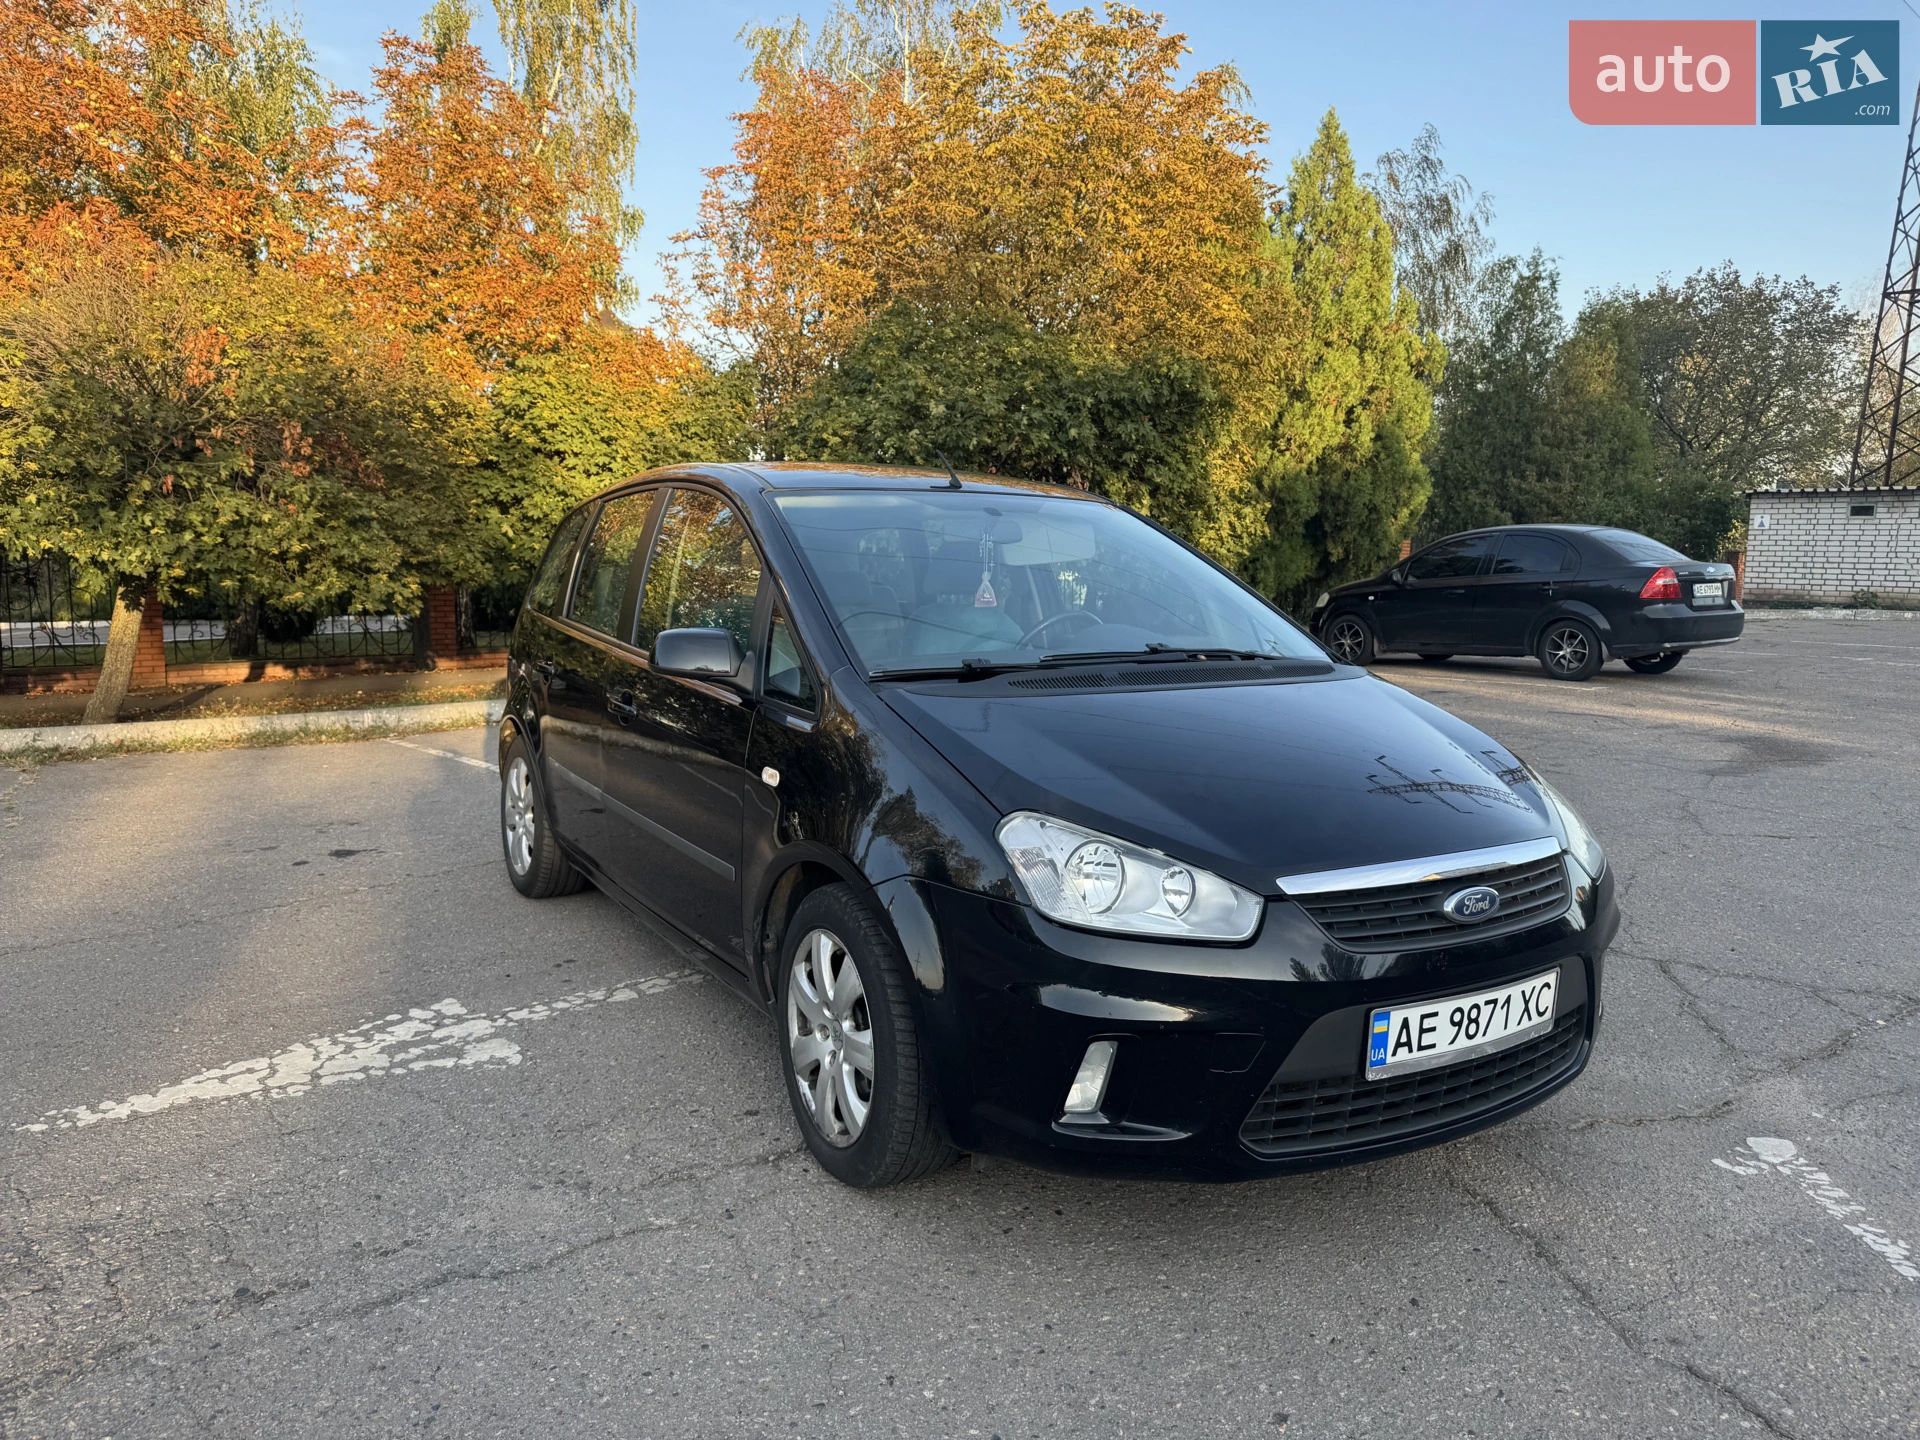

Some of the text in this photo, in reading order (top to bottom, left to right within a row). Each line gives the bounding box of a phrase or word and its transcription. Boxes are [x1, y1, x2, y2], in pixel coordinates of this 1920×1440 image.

[1463, 894, 1490, 915] Ford
[1391, 982, 1552, 1057] AE 9871 XC
[1370, 1048, 1385, 1061] UA
